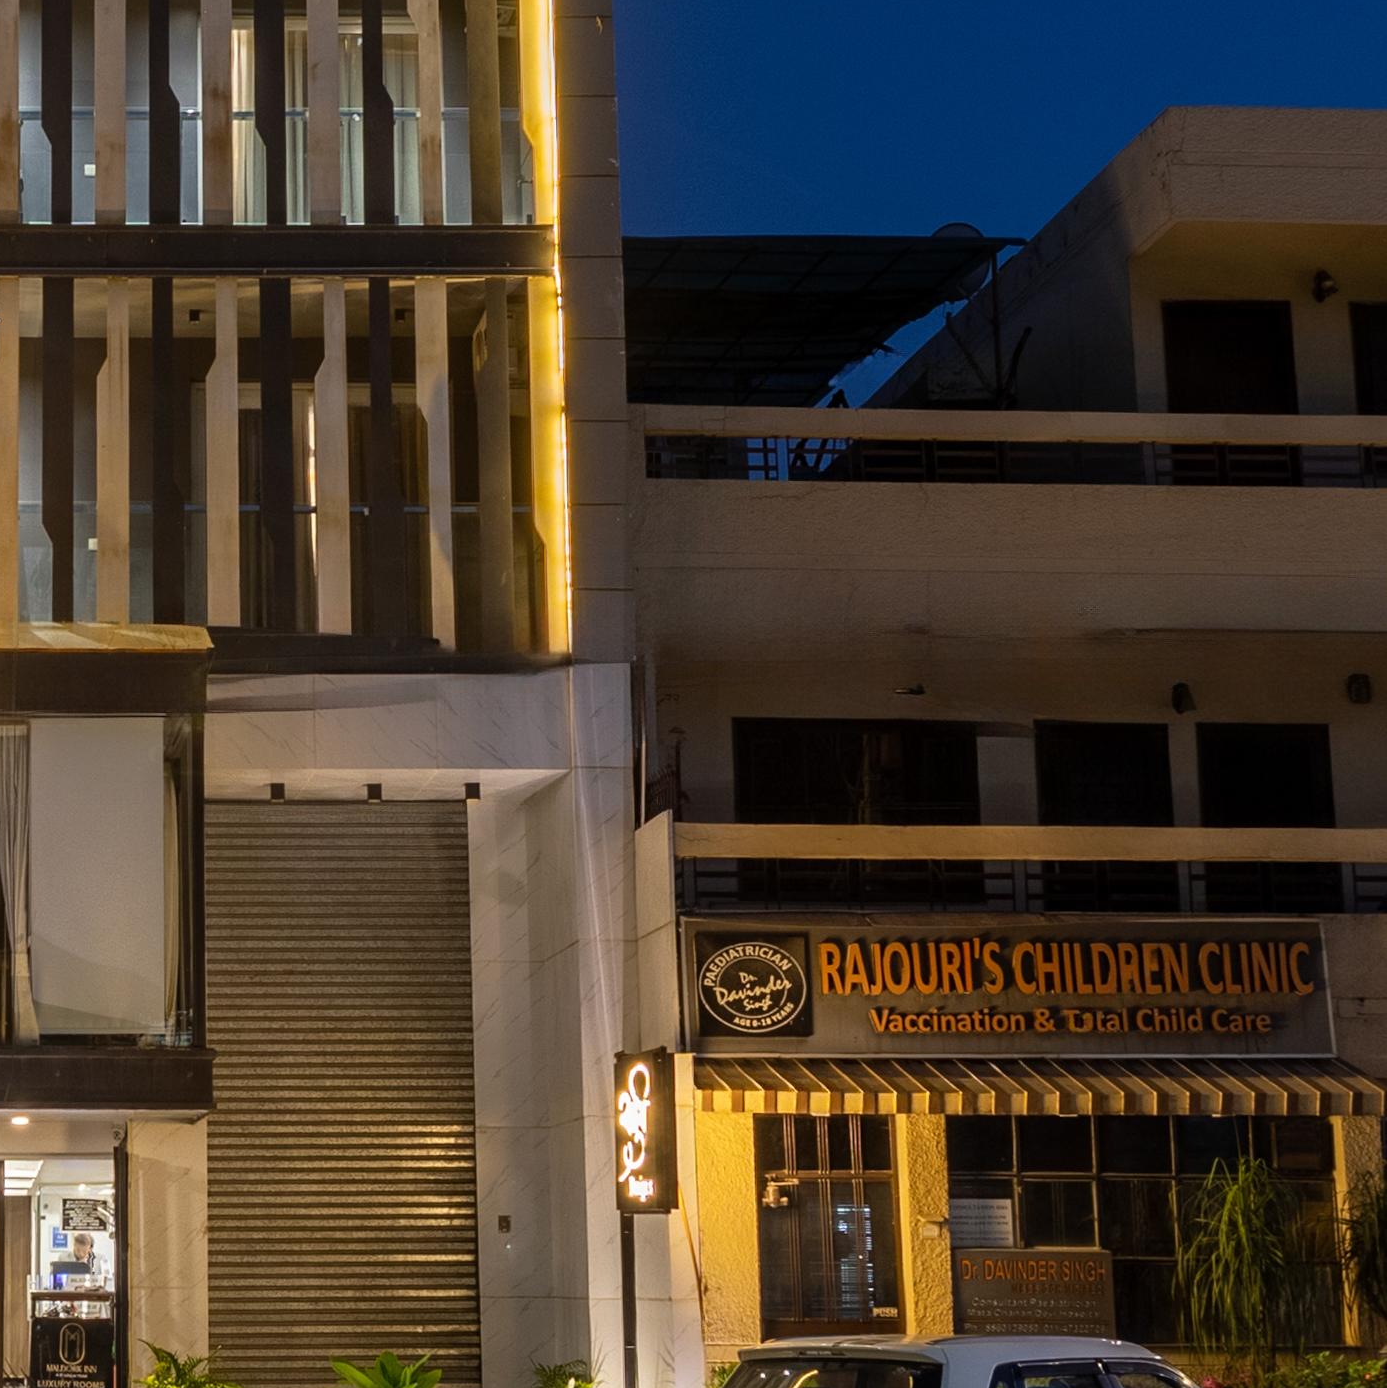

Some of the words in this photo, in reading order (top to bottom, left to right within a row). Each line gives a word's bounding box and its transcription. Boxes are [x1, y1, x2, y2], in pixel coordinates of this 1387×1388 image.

[703, 945, 792, 987] PAEDIATRICIAN
[818, 937, 1005, 996] RAJOURI'S
[1012, 941, 1190, 996] CHILDREN
[1198, 941, 1315, 996] CLINIC
[868, 1007, 1026, 1033] Vaccination
[1033, 1008, 1056, 1032] &
[1136, 1008, 1204, 1033] Child
[1212, 1009, 1273, 1033] Care
[984, 1260, 1058, 1280] DAVINDER
[1061, 1261, 1106, 1281] SINGH
[873, 1307, 898, 1318] PUSH
[37, 1379, 71, 1388] LUXURY
